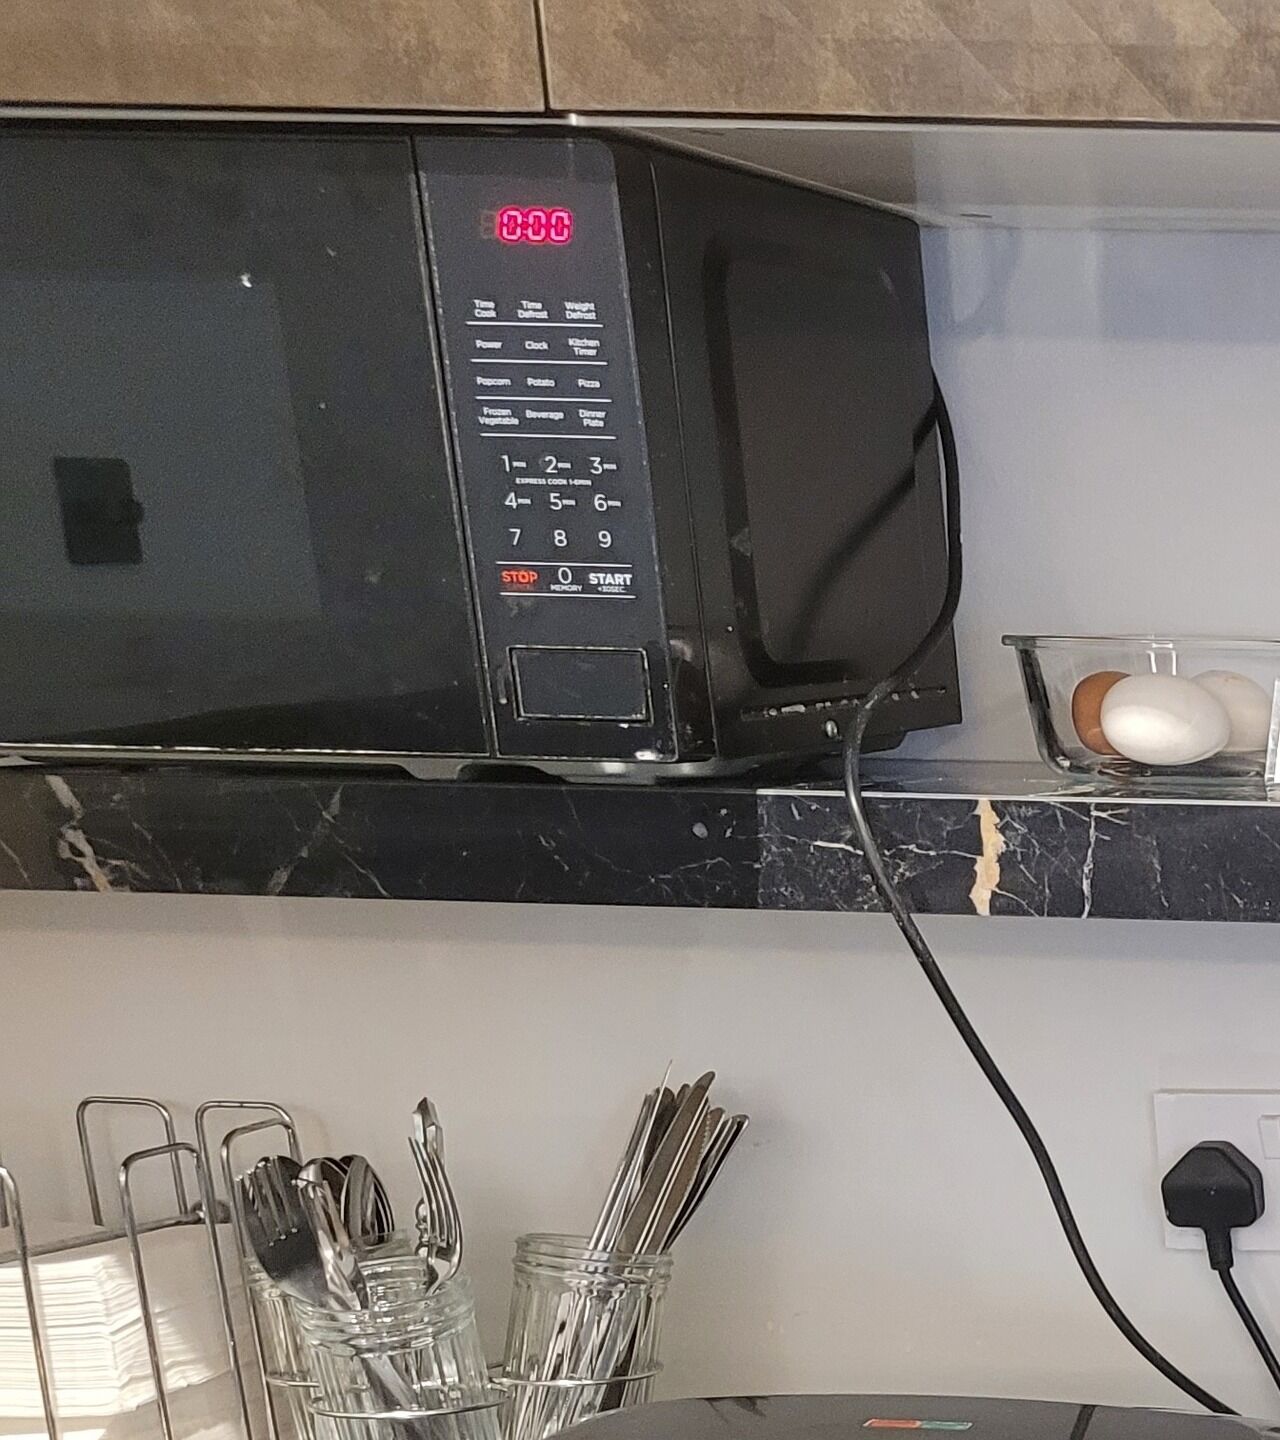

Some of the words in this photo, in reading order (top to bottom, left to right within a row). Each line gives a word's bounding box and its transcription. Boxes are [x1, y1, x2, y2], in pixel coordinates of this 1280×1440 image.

[521, 301, 542, 310] Time
[564, 302, 595, 312] Weight
[475, 340, 502, 349] Power
[525, 341, 549, 350] Clock
[573, 348, 598, 357] Timer
[476, 376, 512, 387] Popcorn
[527, 378, 555, 388] Potato
[578, 379, 600, 389] Pizza
[483, 407, 512, 417] Frozen
[525, 410, 564, 421] Beverage
[579, 410, 606, 420] Dinner
[508, 528, 521, 546] 7
[554, 529, 568, 547] 8
[598, 531, 612, 548] 9
[501, 570, 538, 583] STOP
[558, 567, 572, 584] 0
[588, 572, 633, 586] START
[550, 584, 583, 592] MEMORY
